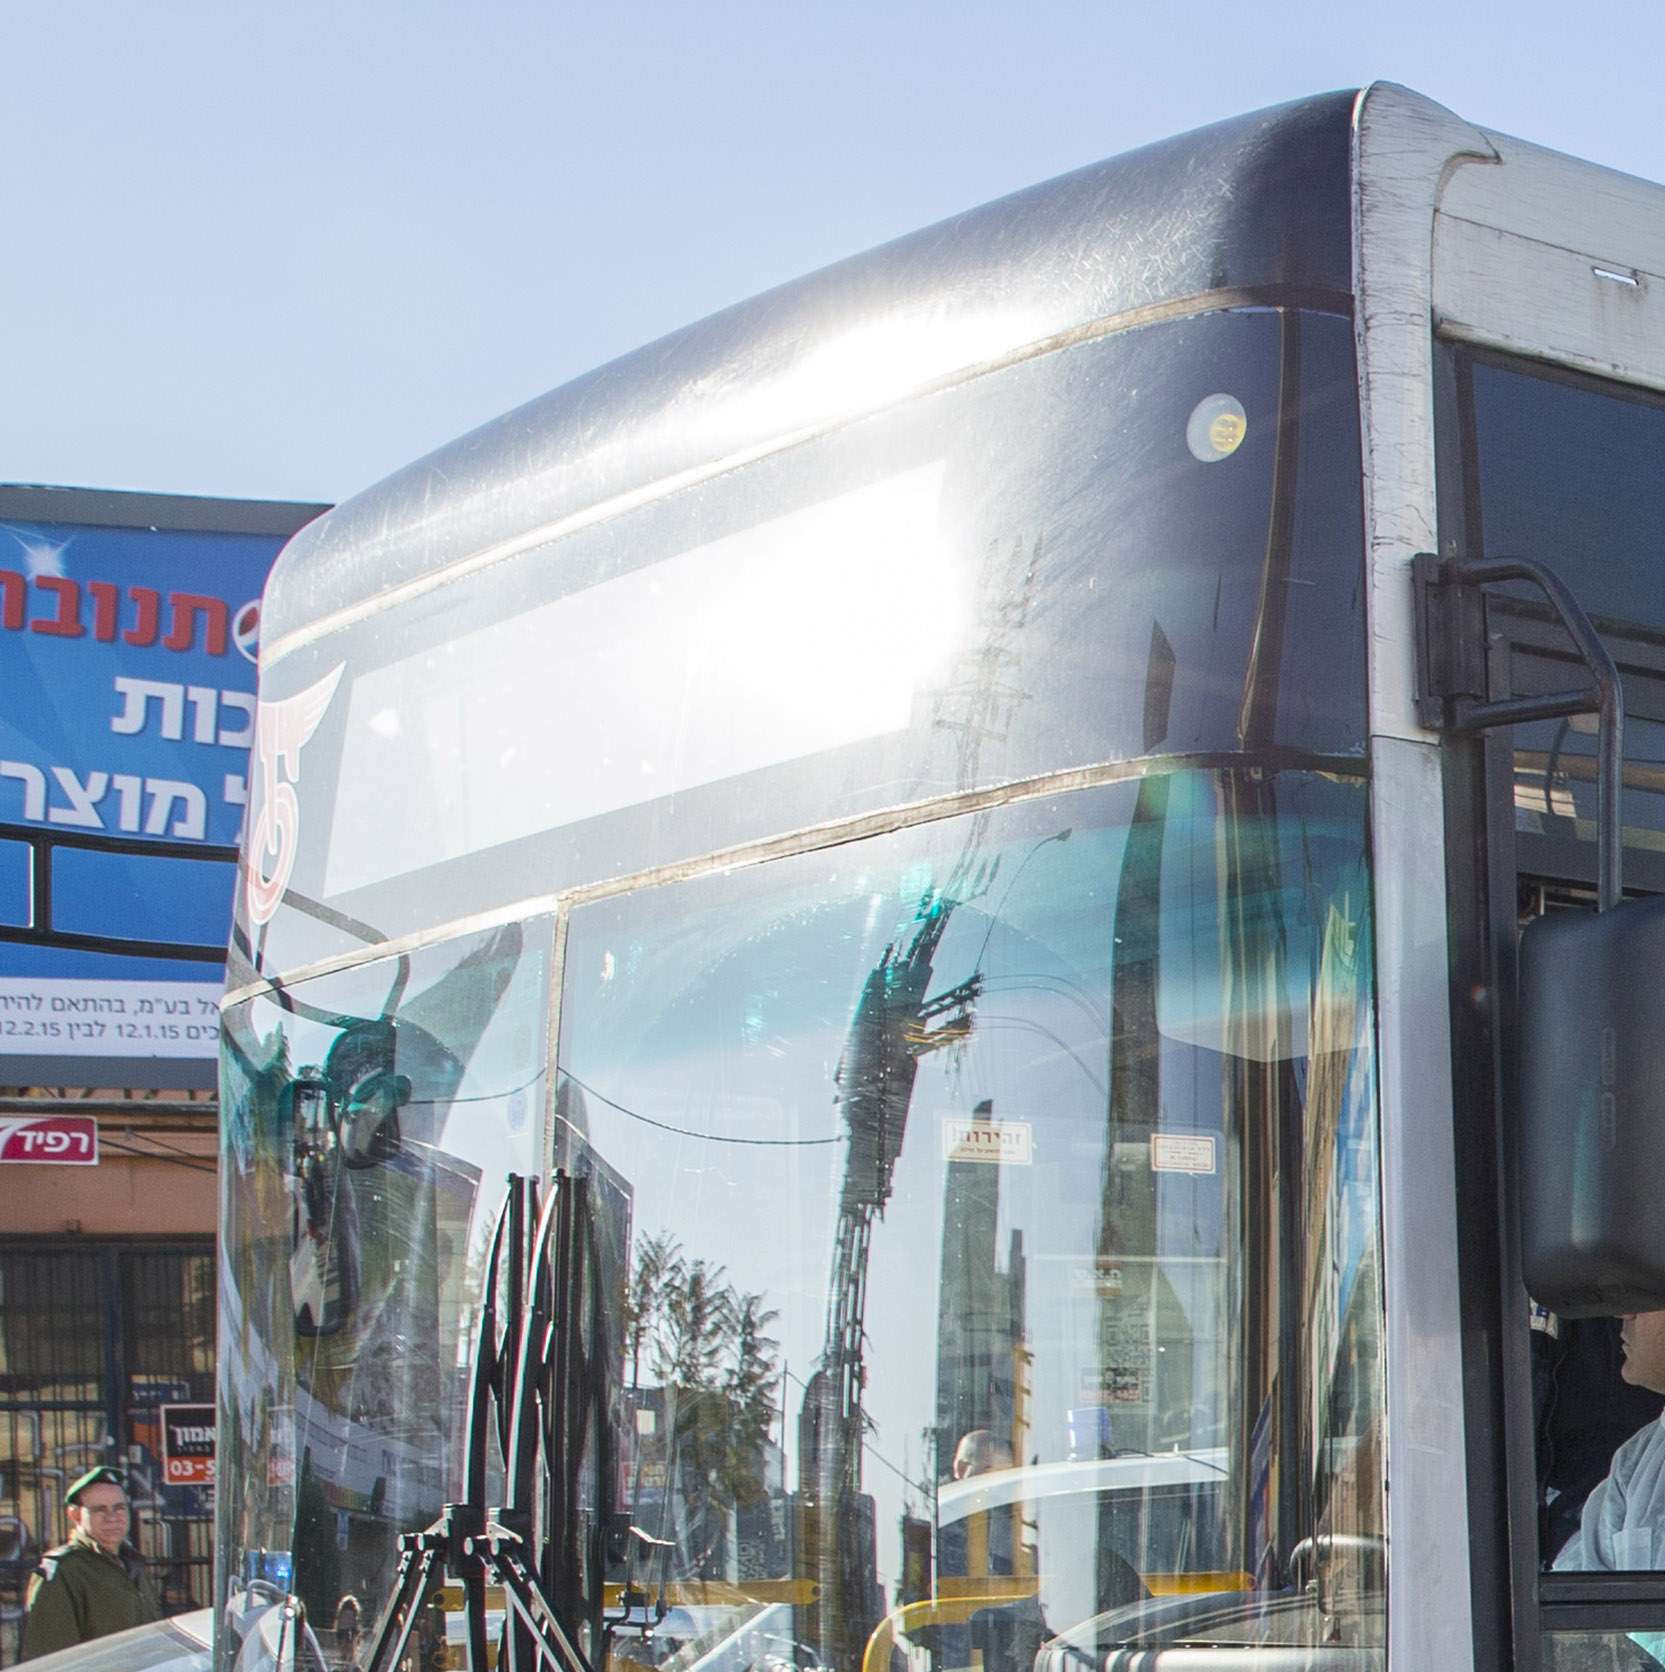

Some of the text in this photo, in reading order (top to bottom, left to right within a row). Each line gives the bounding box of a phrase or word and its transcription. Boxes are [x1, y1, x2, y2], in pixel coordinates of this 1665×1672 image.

[51, 997, 126, 1013] בהתאם
[67, 1020, 107, 1041] לבין
[16, 1130, 89, 1153] רפיד
